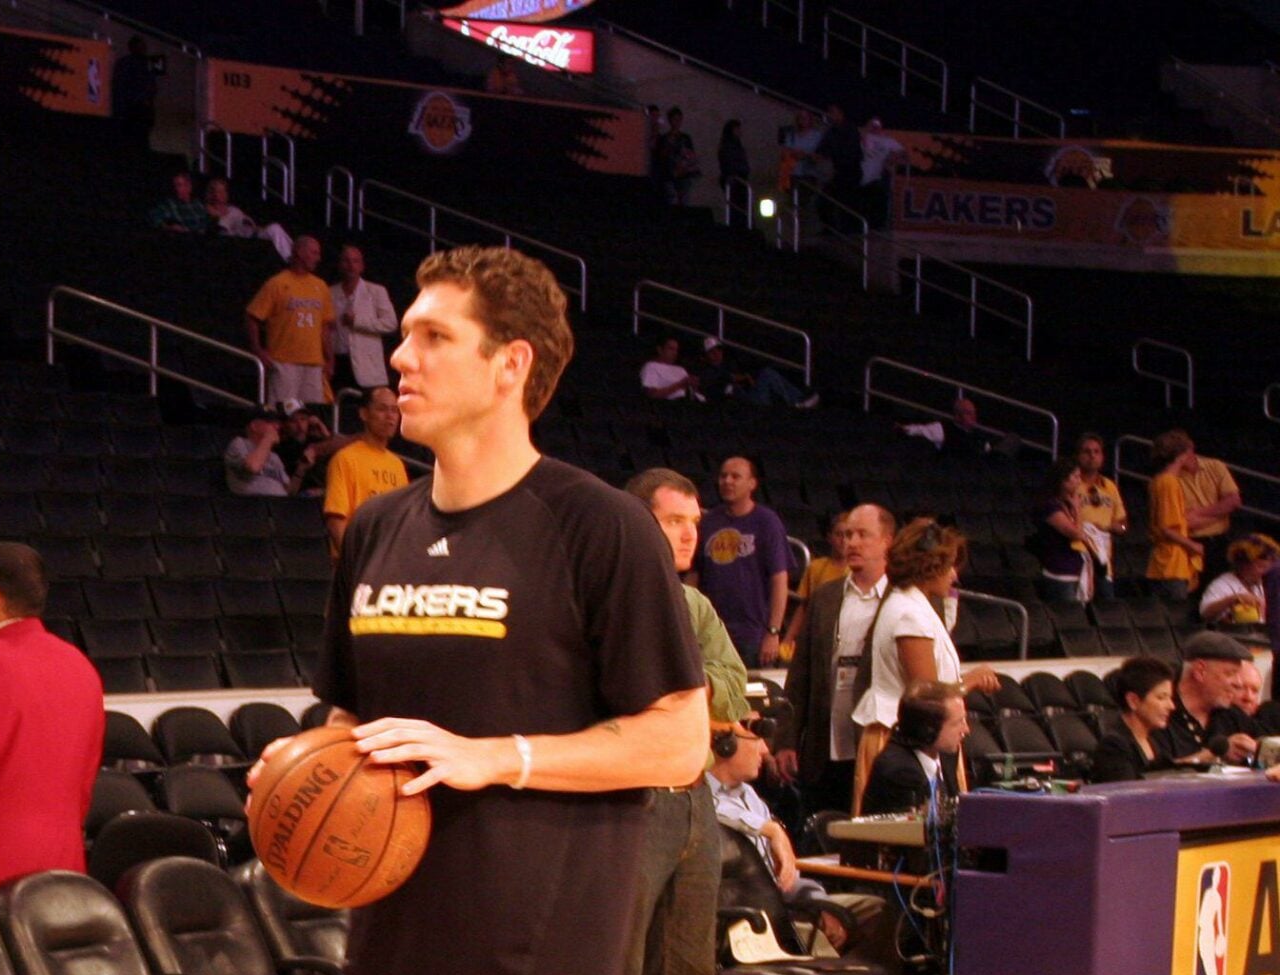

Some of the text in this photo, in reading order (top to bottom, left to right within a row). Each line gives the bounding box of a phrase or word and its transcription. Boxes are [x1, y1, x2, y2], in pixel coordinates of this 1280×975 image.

[223, 72, 251, 89] 103
[902, 188, 1057, 229] LAKERS
[351, 583, 509, 620] LAKERS
[267, 762, 339, 877] SPALDING
